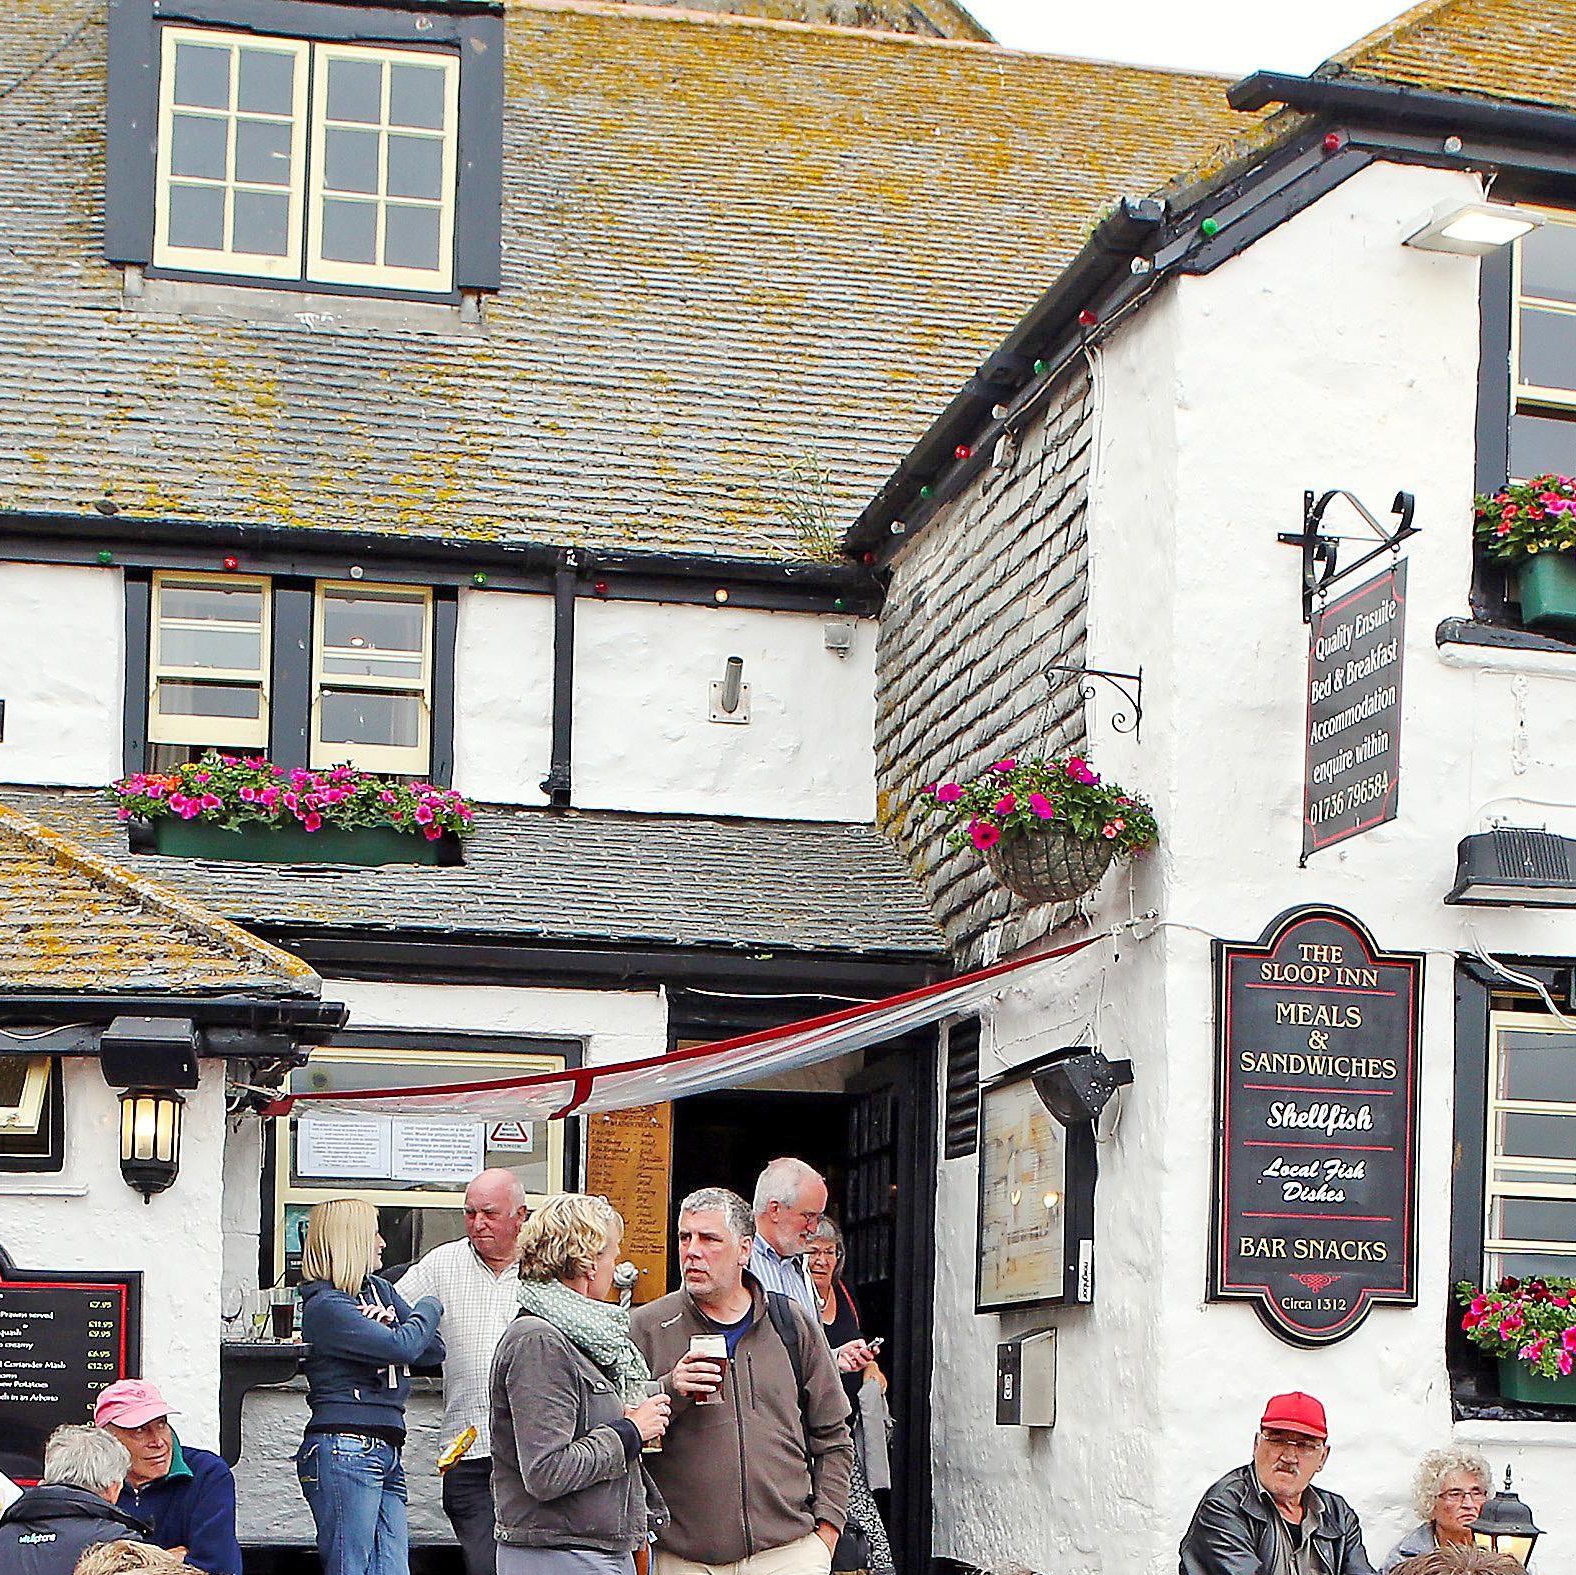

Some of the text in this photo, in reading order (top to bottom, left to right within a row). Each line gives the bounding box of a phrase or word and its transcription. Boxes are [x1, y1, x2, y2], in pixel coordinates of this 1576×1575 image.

[1316, 600, 1397, 661] Quality Ensuite
[1311, 638, 1397, 704] Bed & Breakfast
[1310, 685, 1396, 745] Accommodation
[1313, 730, 1389, 785] enquire within
[1311, 771, 1389, 825] 01736 796584
[1298, 944, 1343, 963] THE
[1261, 963, 1379, 988] SLOOP INN
[1275, 1003, 1362, 1028] MEALS
[1309, 1030, 1328, 1050] &
[1241, 1052, 1397, 1079] SANDWICHES
[1267, 1103, 1373, 1136] Shellfish
[1263, 1157, 1365, 1181] Local Fish
[1282, 1182, 1346, 1202] Dishes
[1240, 1237, 1387, 1262] BAR SNACKS
[1281, 1297, 1346, 1311] Circa 1312
